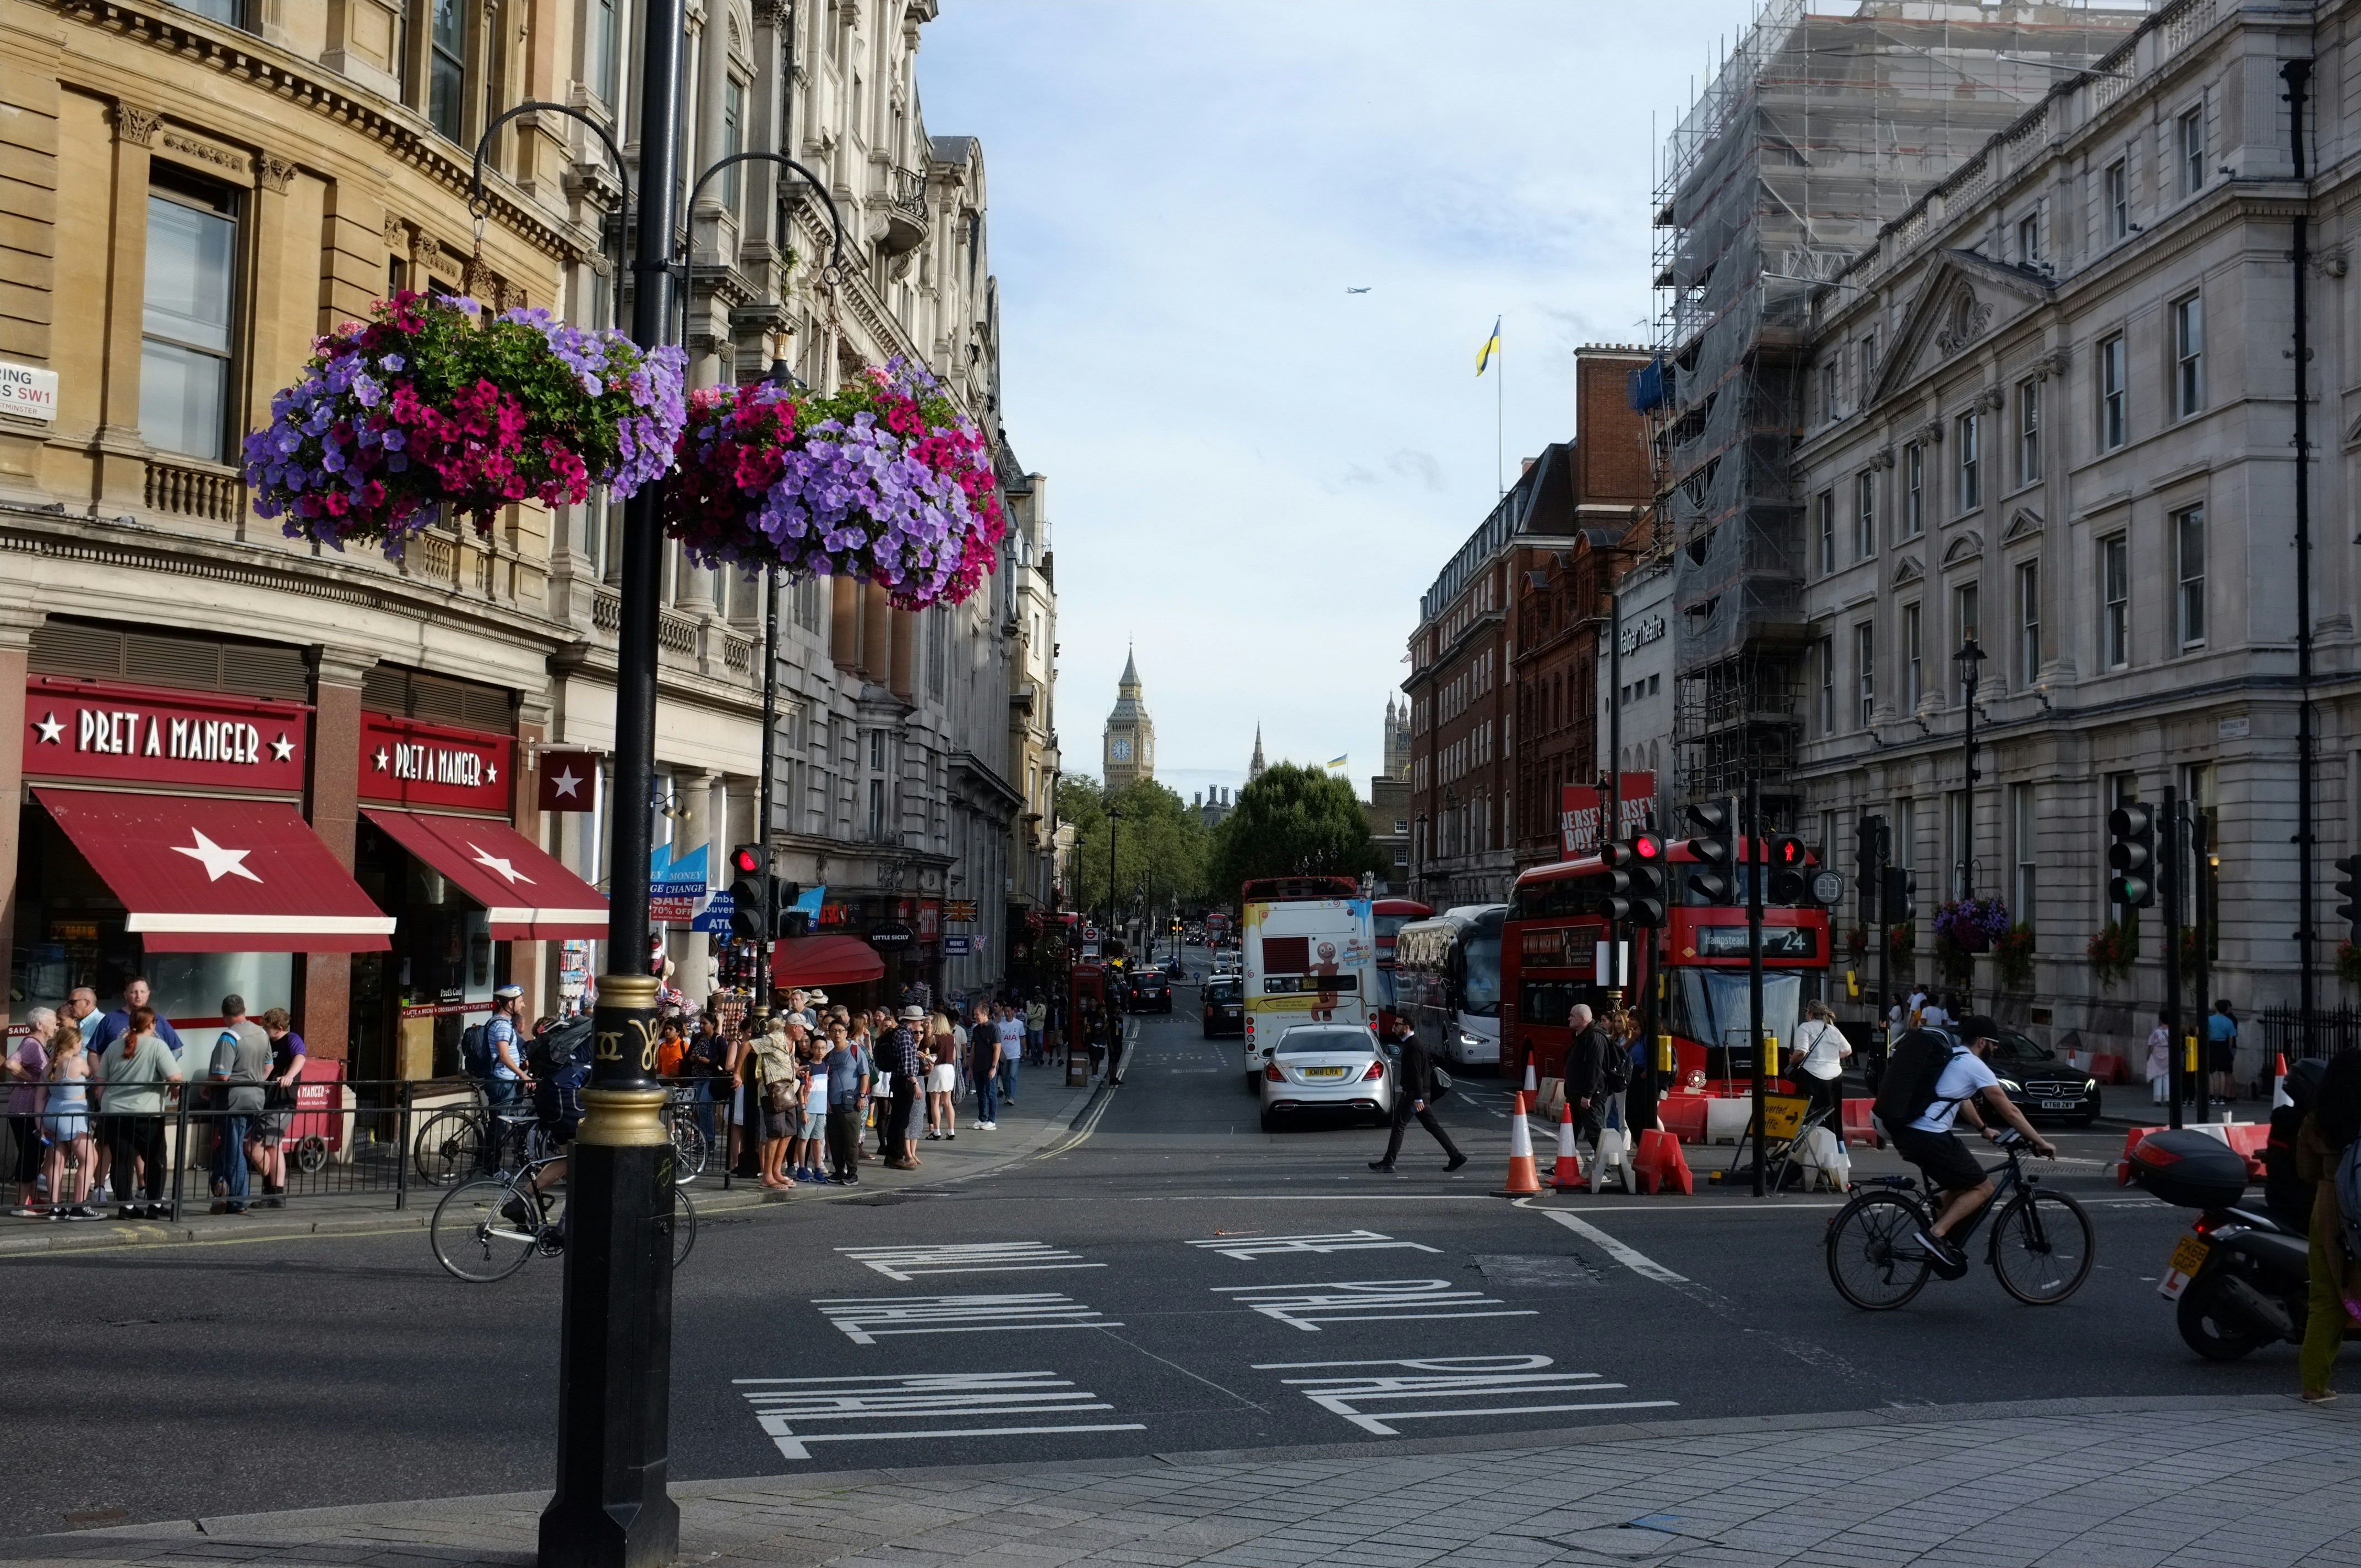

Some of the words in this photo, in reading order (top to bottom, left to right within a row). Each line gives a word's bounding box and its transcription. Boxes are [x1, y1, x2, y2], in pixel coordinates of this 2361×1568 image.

[0, 368, 31, 385] ING
[18, 387, 50, 404] SW1
[1620, 628, 1638, 656] falgar
[1638, 616, 1662, 646] Theatre
[79, 709, 139, 754] PRET
[145, 715, 161, 756] A
[170, 717, 259, 764] MANGER
[395, 743, 424, 780] PRET
[427, 748, 434, 781] A
[438, 749, 481, 787] MANGER
[1620, 797, 1653, 820] RSEY
[668, 871, 703, 880] MONEY
[666, 884, 704, 894] CHANGE
[652, 897, 693, 906] SALE
[652, 906, 672, 915] 70%
[675, 907, 692, 916] OFF
[921, 908, 937, 934] GIFTS
[1705, 934, 1744, 948] Hampstead
[1782, 934, 1806, 951] 24
[440, 988, 452, 997] Pret's
[453, 987, 463, 996] Cool
[302, 1085, 324, 1098] MANGER
[1765, 1103, 1788, 1115] verted
[1765, 1118, 1778, 1130] ffic
[1184, 1231, 1445, 1260] THE
[833, 1241, 1108, 1281] MALL
[2166, 1270, 2179, 1291] L
[1210, 1280, 1540, 1331] PALL
[810, 1293, 1125, 1344] MALL
[1250, 1355, 1680, 1435] PALL
[732, 1371, 1147, 1460] MALL
